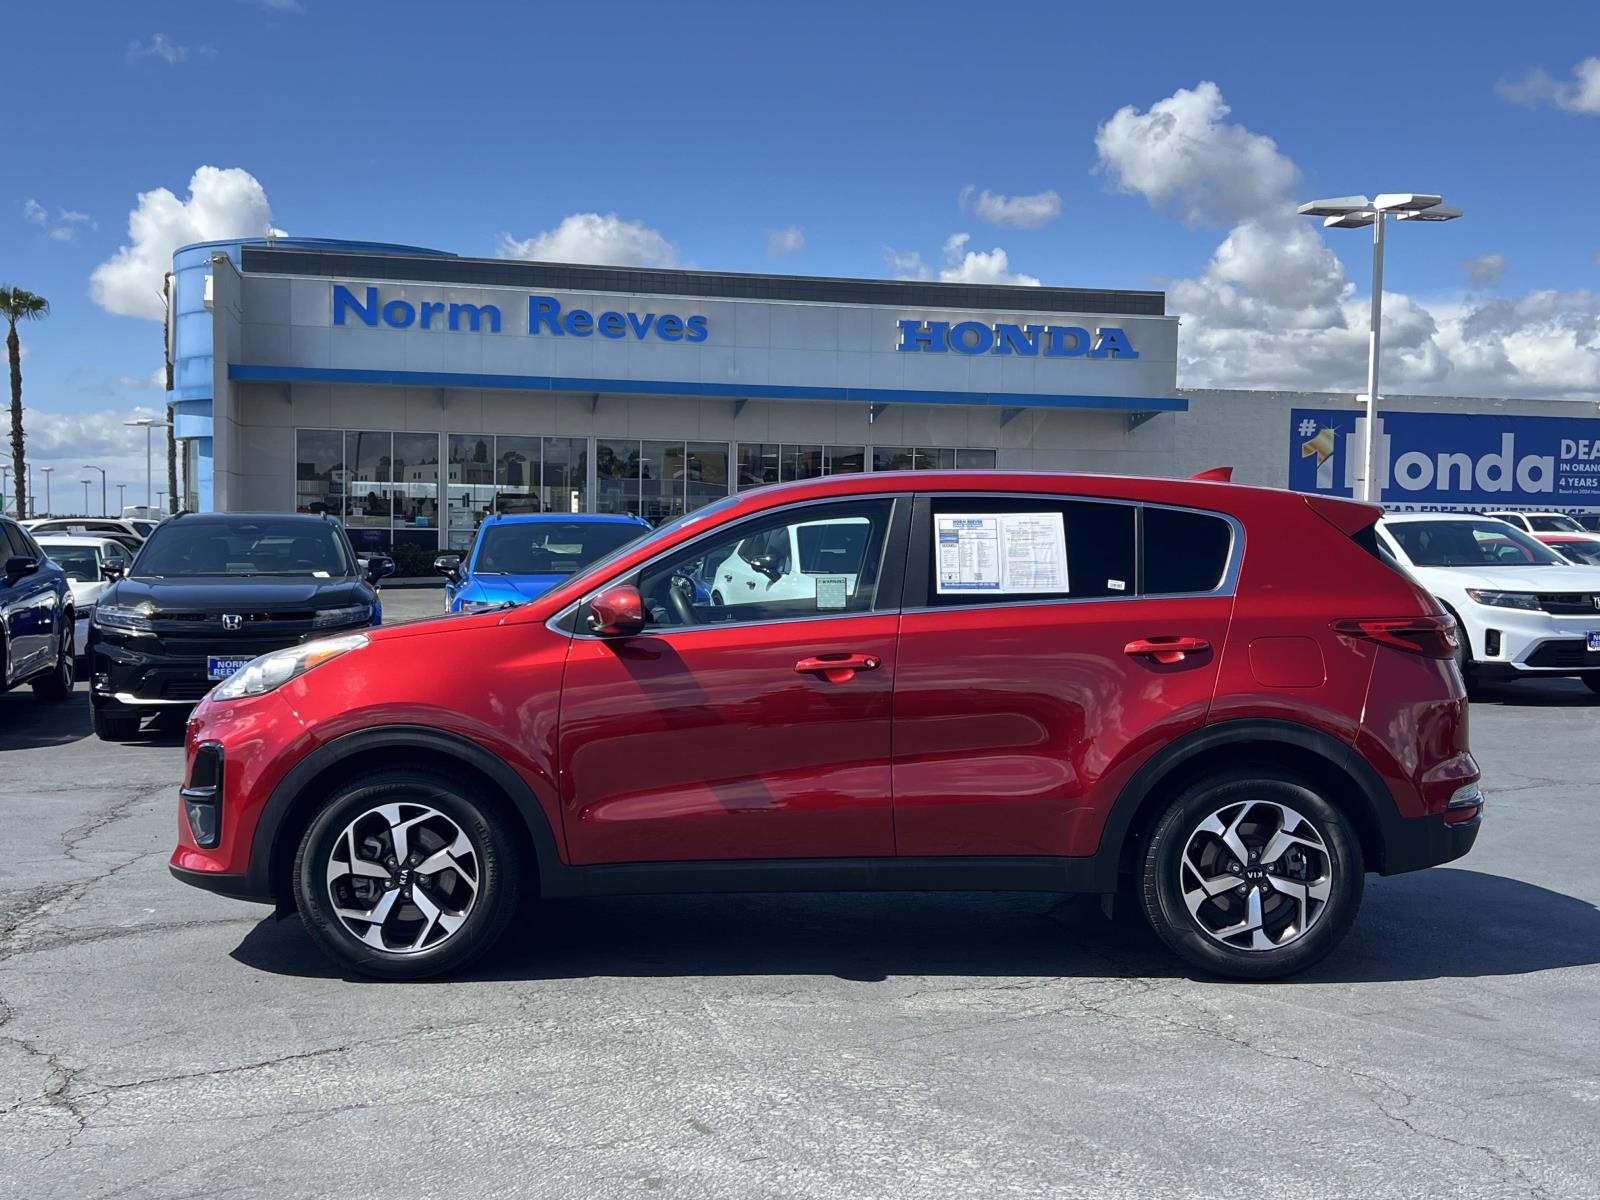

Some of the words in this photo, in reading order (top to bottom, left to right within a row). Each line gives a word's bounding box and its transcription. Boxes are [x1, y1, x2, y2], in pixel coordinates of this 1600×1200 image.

[332, 285, 501, 333] Norm
[527, 295, 709, 343] Reeves
[896, 319, 1140, 359] HONDA
[1560, 463, 1570, 472] IN
[1559, 477, 1566, 487] 4
[1567, 477, 1599, 487] YEARS
